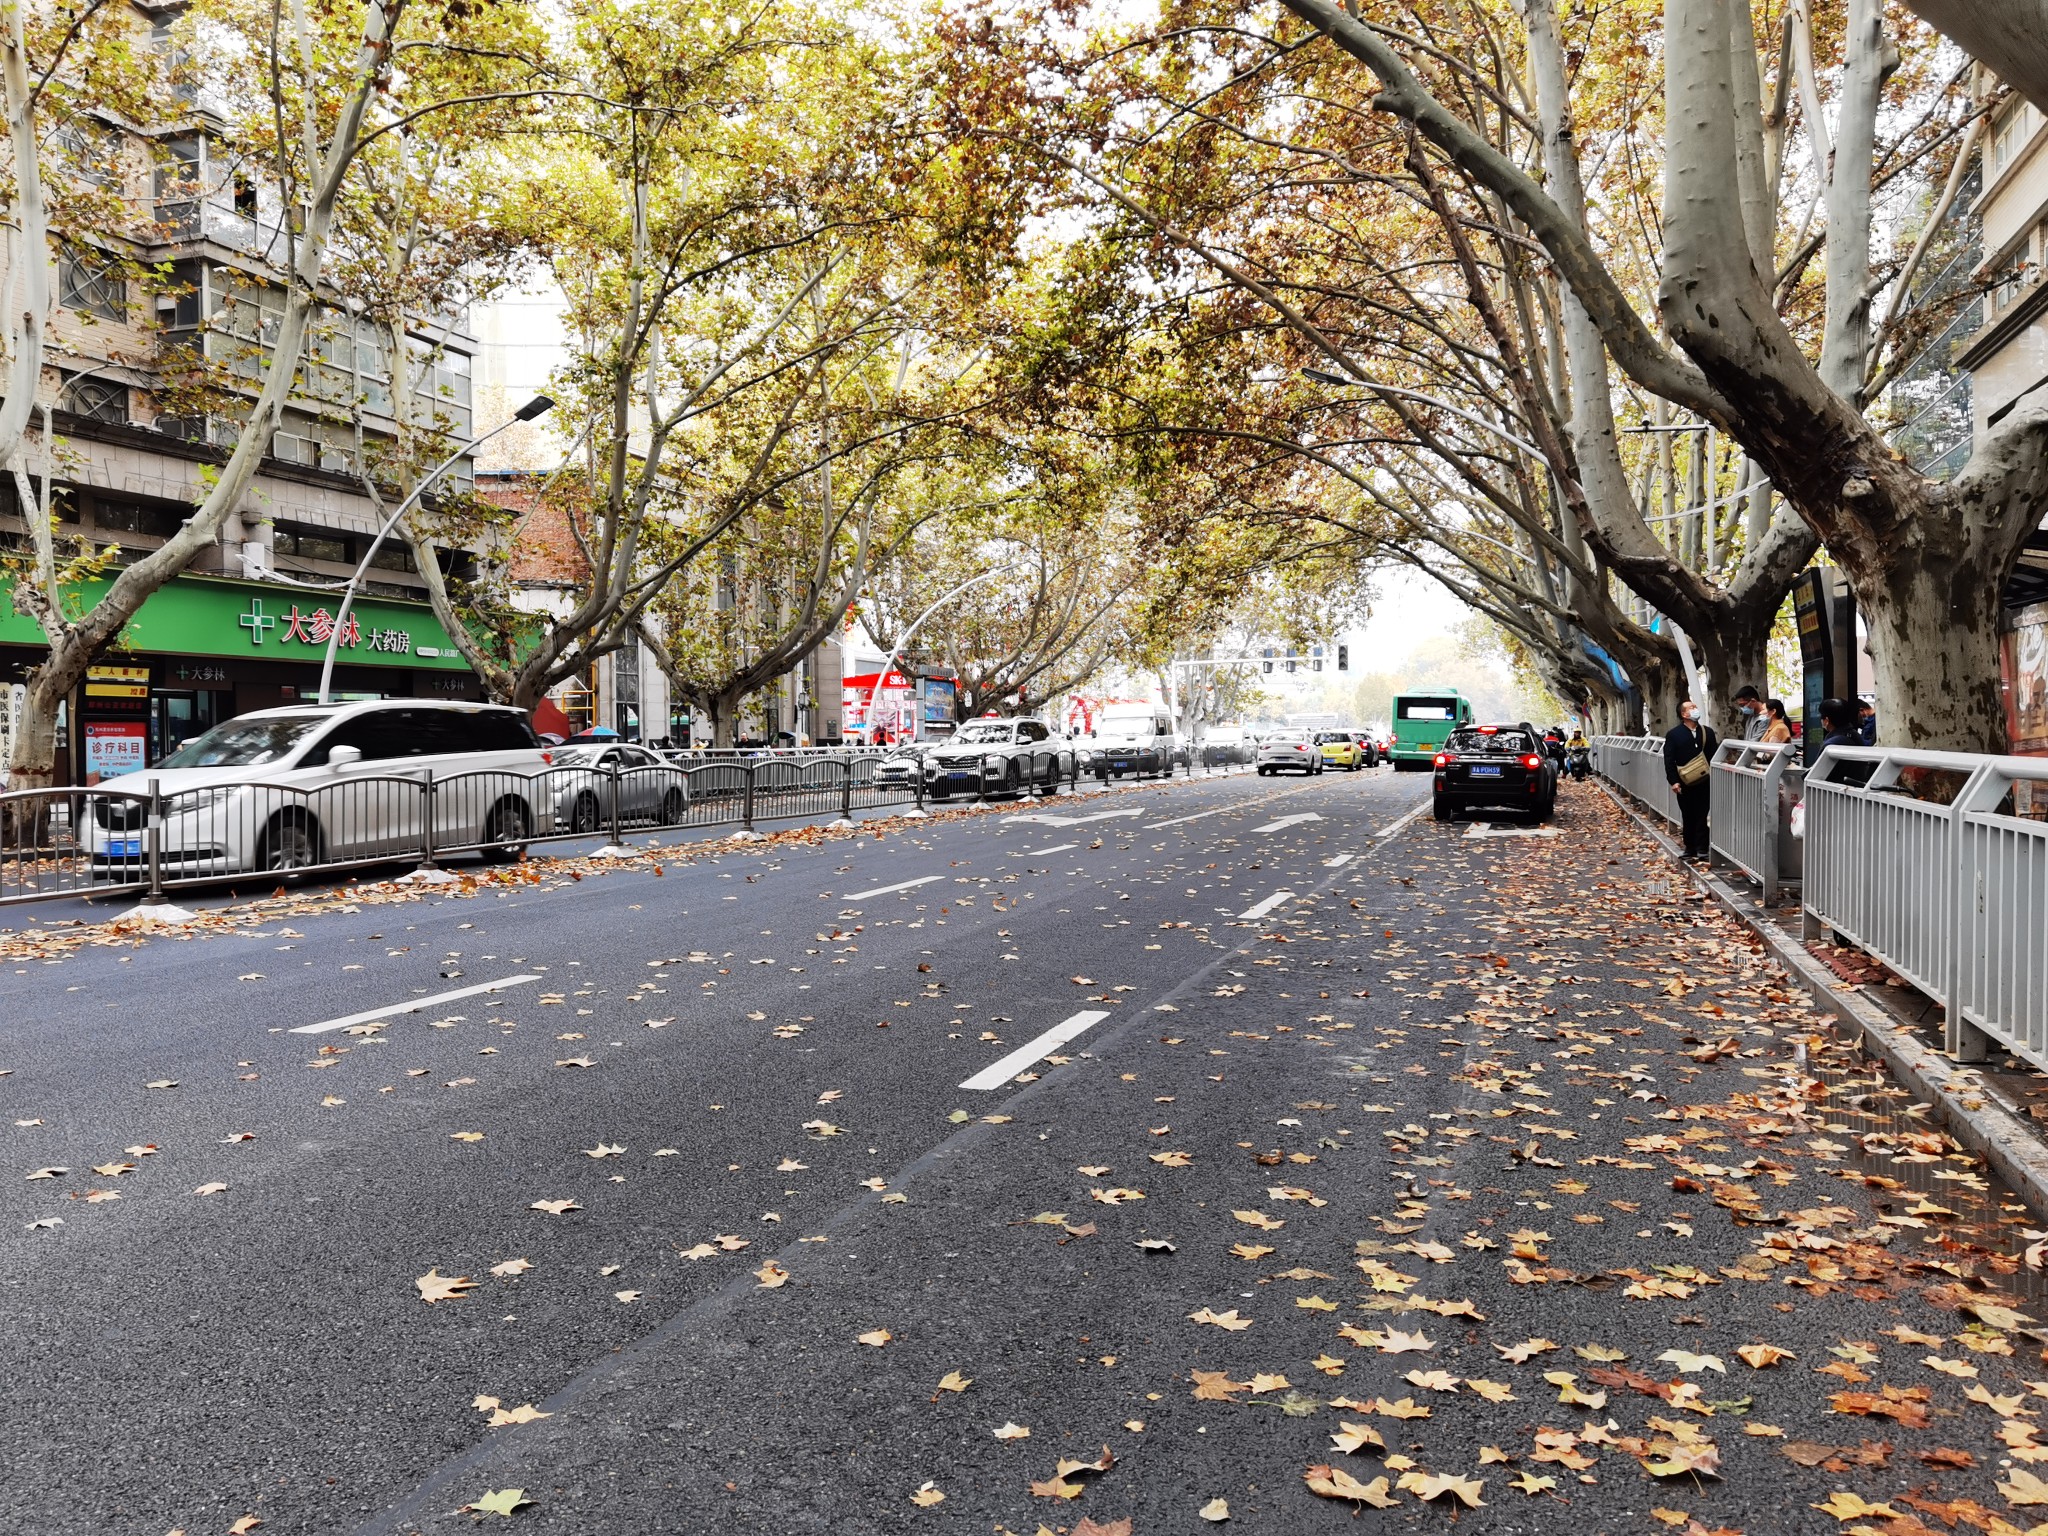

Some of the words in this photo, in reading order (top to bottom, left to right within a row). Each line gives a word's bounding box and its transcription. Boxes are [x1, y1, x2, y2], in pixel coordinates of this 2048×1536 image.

[281, 605, 362, 648] 大参林
[367, 628, 411, 654] 大药房
[191, 665, 226, 681] 大参林
[442, 679, 465, 691] 大参林
[92, 742, 140, 754] 诊疗科目
